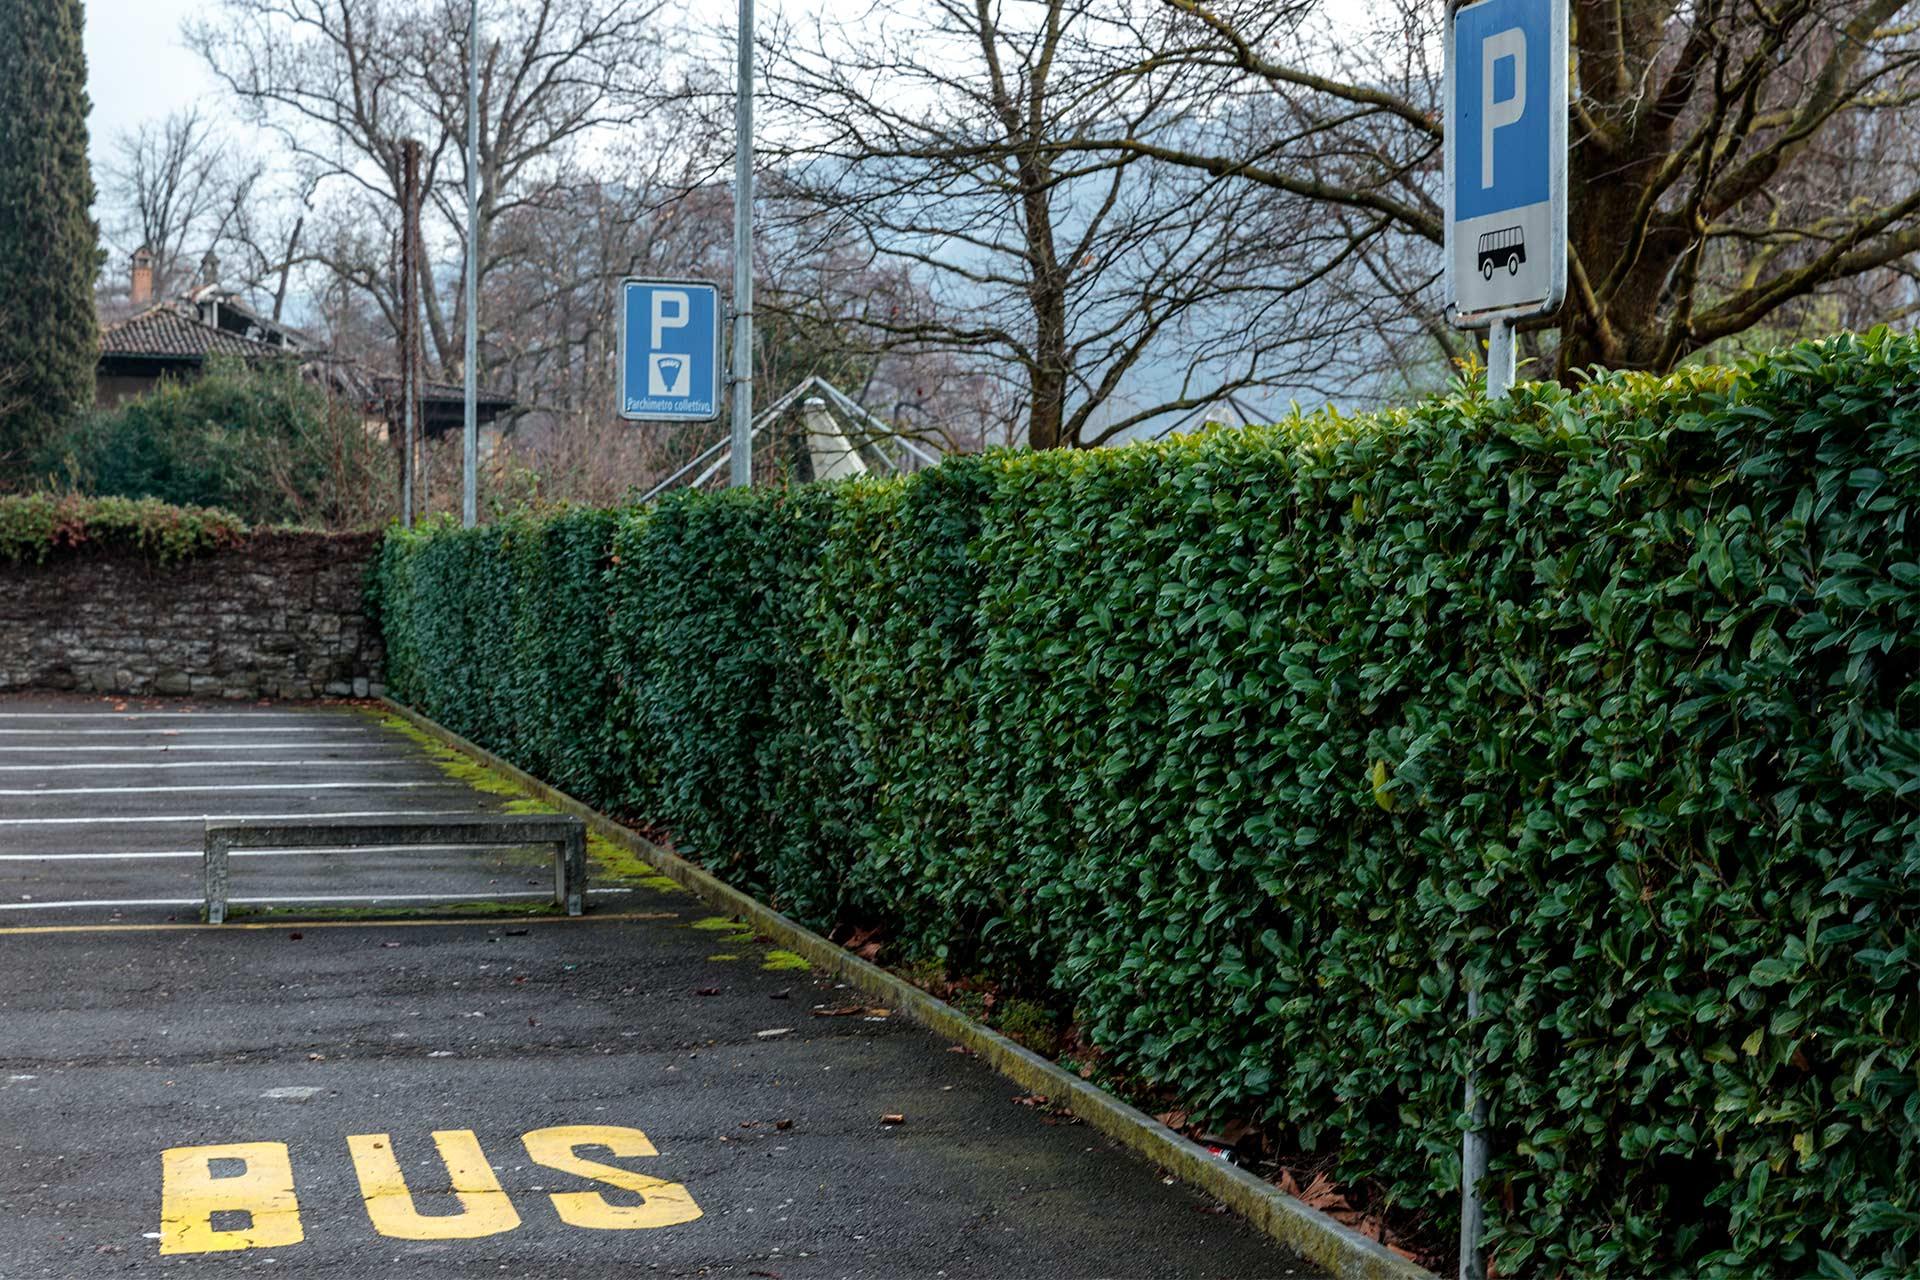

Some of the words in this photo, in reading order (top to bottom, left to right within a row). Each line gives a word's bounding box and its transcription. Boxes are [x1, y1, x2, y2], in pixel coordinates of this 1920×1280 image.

[1481, 26, 1527, 190] P
[650, 289, 690, 350] P
[626, 397, 673, 411] Parchimetro
[674, 399, 711, 412] collettivo
[159, 1125, 704, 1256] BUS
